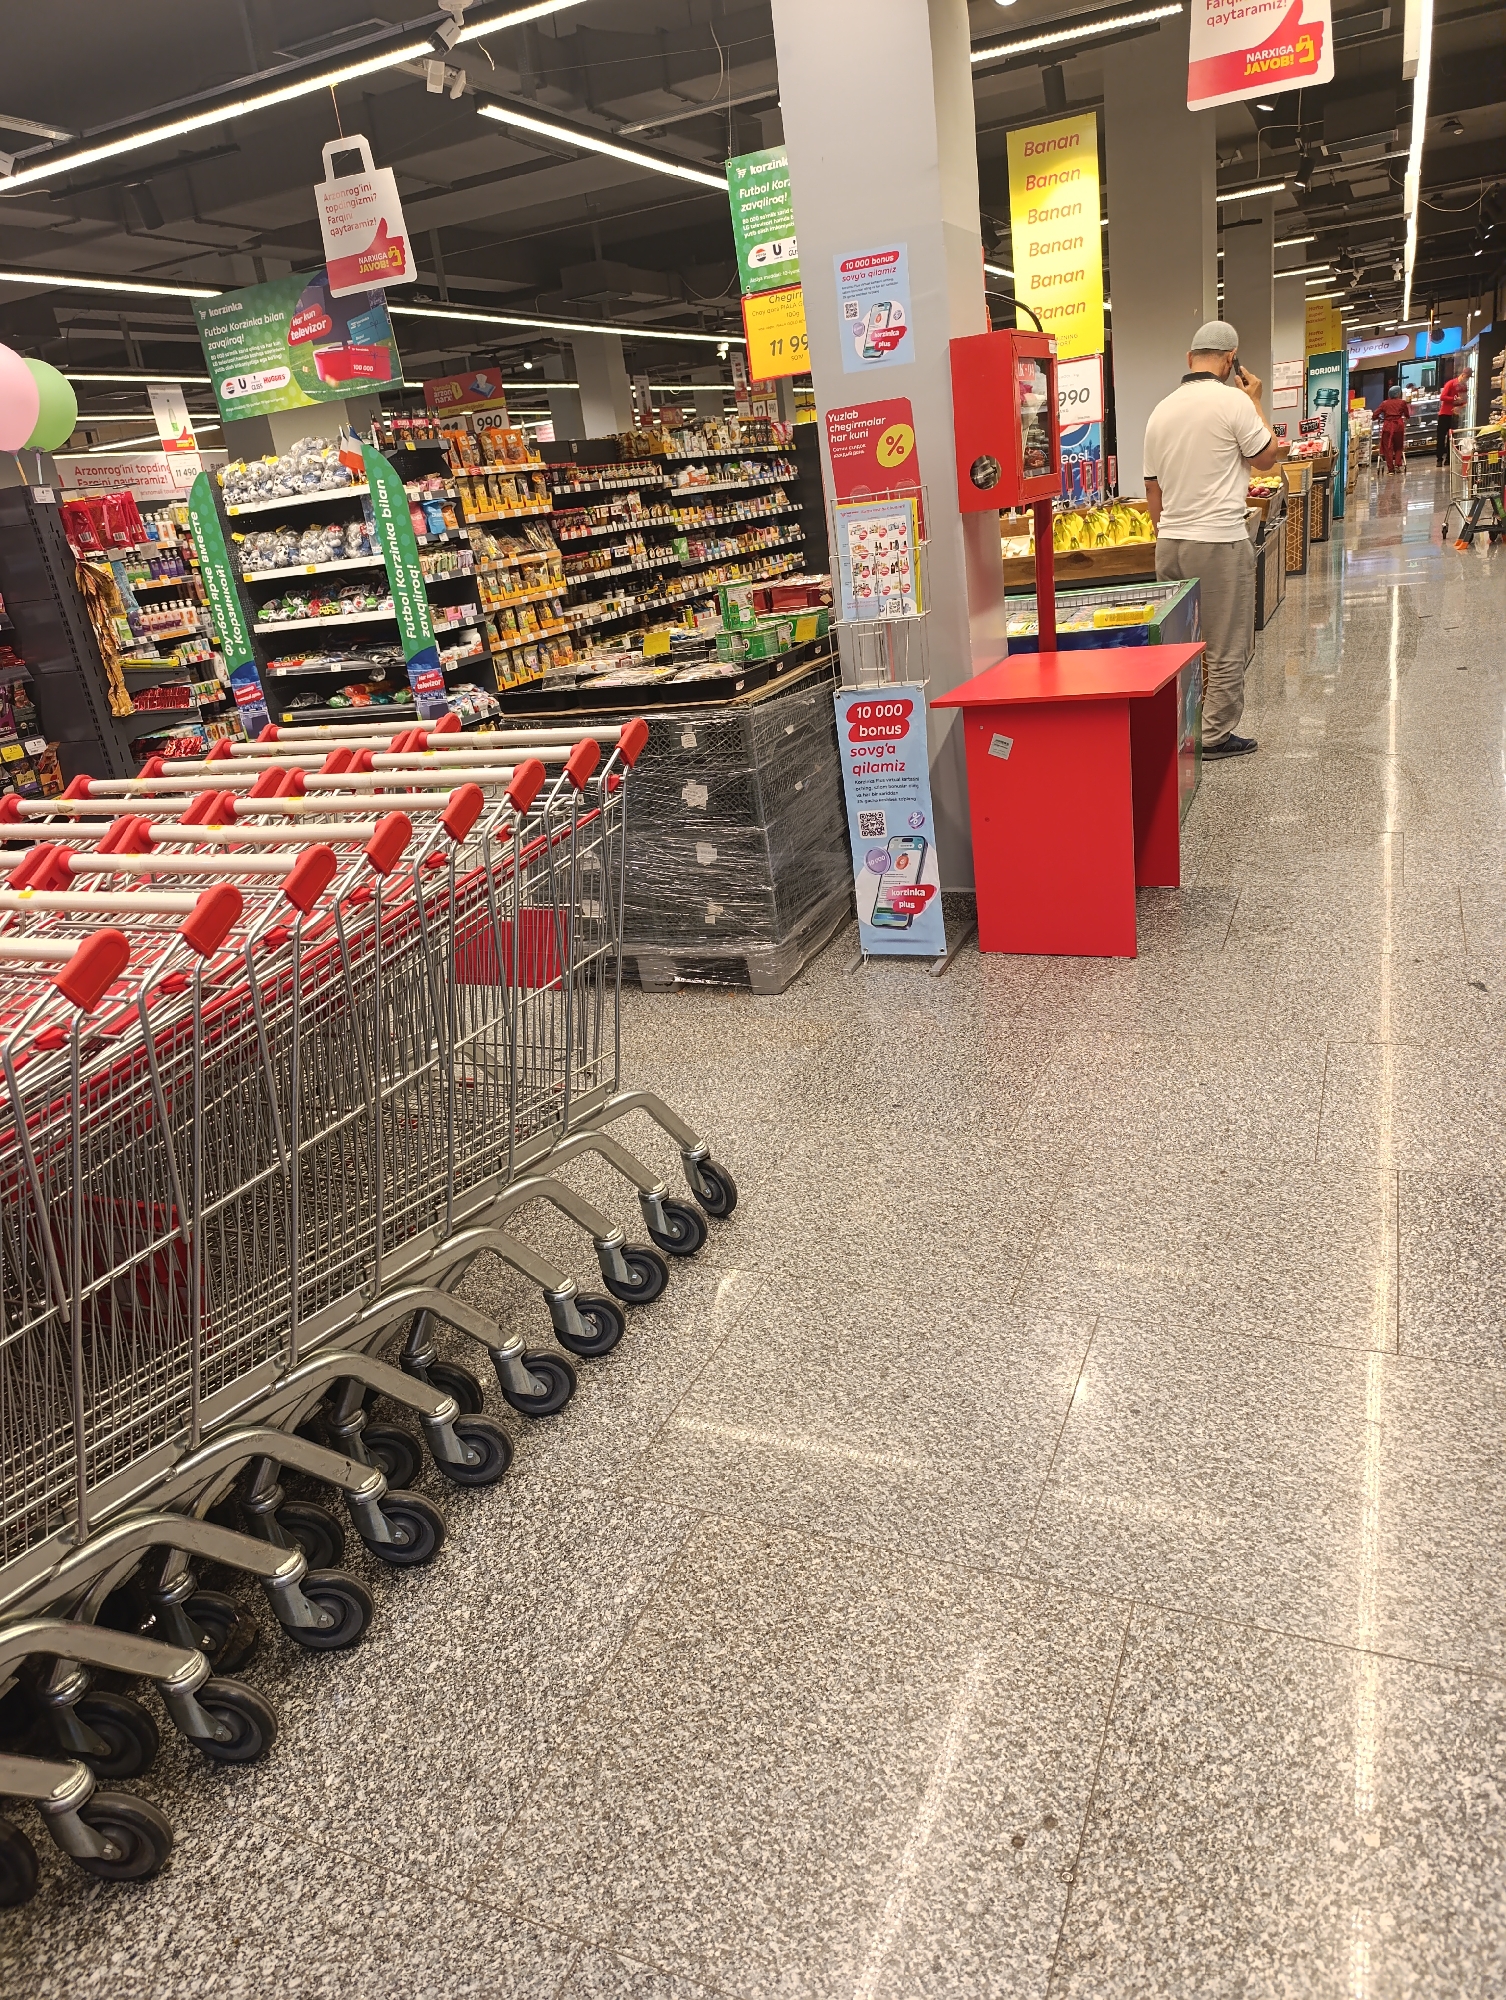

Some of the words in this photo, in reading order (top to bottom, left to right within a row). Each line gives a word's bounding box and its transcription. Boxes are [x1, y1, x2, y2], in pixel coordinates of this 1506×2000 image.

[1206, 0, 1246, 10] Farq
[1246, 45, 1294, 63] NARXIGA
[1244, 54, 1294, 76] JAVOB!
[1024, 133, 1079, 157] Banan
[1026, 168, 1080, 191] Banan
[323, 182, 372, 202] Arzonrog'ini
[740, 182, 769, 198] Futbol
[325, 193, 377, 213] topdingizmi?
[741, 192, 787, 212] zavqliroq!
[327, 212, 353, 225] Farqini
[1028, 202, 1082, 225] Banan
[330, 217, 377, 237] qaytaramiz!
[1029, 236, 1083, 257] Banan
[359, 252, 388, 264] NARXIGA
[846, 262, 854, 270] 10
[855, 258, 870, 268] 000
[872, 254, 894, 265] bonus
[359, 260, 389, 273] JAVOB!
[868, 266, 897, 278] qilamiz
[1031, 269, 1084, 290] Banan
[209, 302, 243, 317] korzinka
[1033, 301, 1086, 320] Banan
[205, 327, 228, 337] Futbol
[230, 317, 263, 331] Korzinka
[264, 312, 285, 324] bilan
[292, 317, 303, 326] Har
[304, 310, 316, 321] kun
[290, 319, 327, 341] televizor
[874, 329, 900, 338] korzinka
[770, 339, 783, 356] 11
[878, 340, 891, 349] plus
[1363, 342, 1390, 354] yerda
[1310, 365, 1340, 376] BORJOMI
[263, 374, 286, 384] HUGGIES
[433, 389, 452, 398] arzon
[1058, 388, 1090, 407] 990
[477, 414, 502, 431] 990
[828, 410, 859, 423] Yuzlab
[829, 417, 886, 433] chegirmalar
[831, 434, 847, 443] har
[849, 428, 869, 440] kuni
[74, 463, 134, 476] Arzonrog'ini
[175, 469, 182, 477] 11
[183, 467, 197, 476] 490
[376, 479, 392, 518] bilan
[191, 511, 209, 563] вместе
[386, 522, 407, 588] Korzinka
[205, 566, 219, 601] ярче
[215, 564, 243, 644] Корзинкой!
[407, 564, 430, 638] zavqliroq!
[399, 591, 417, 639] Futbol
[215, 604, 234, 656] Футбол
[417, 679, 442, 690] televizor
[857, 706, 872, 719] 10
[876, 703, 903, 718] 000
[859, 724, 902, 737] bonus
[850, 742, 896, 758] sovg'a
[852, 760, 906, 776] qilamiz
[891, 888, 926, 897] korzinka
[899, 900, 915, 909] plus
